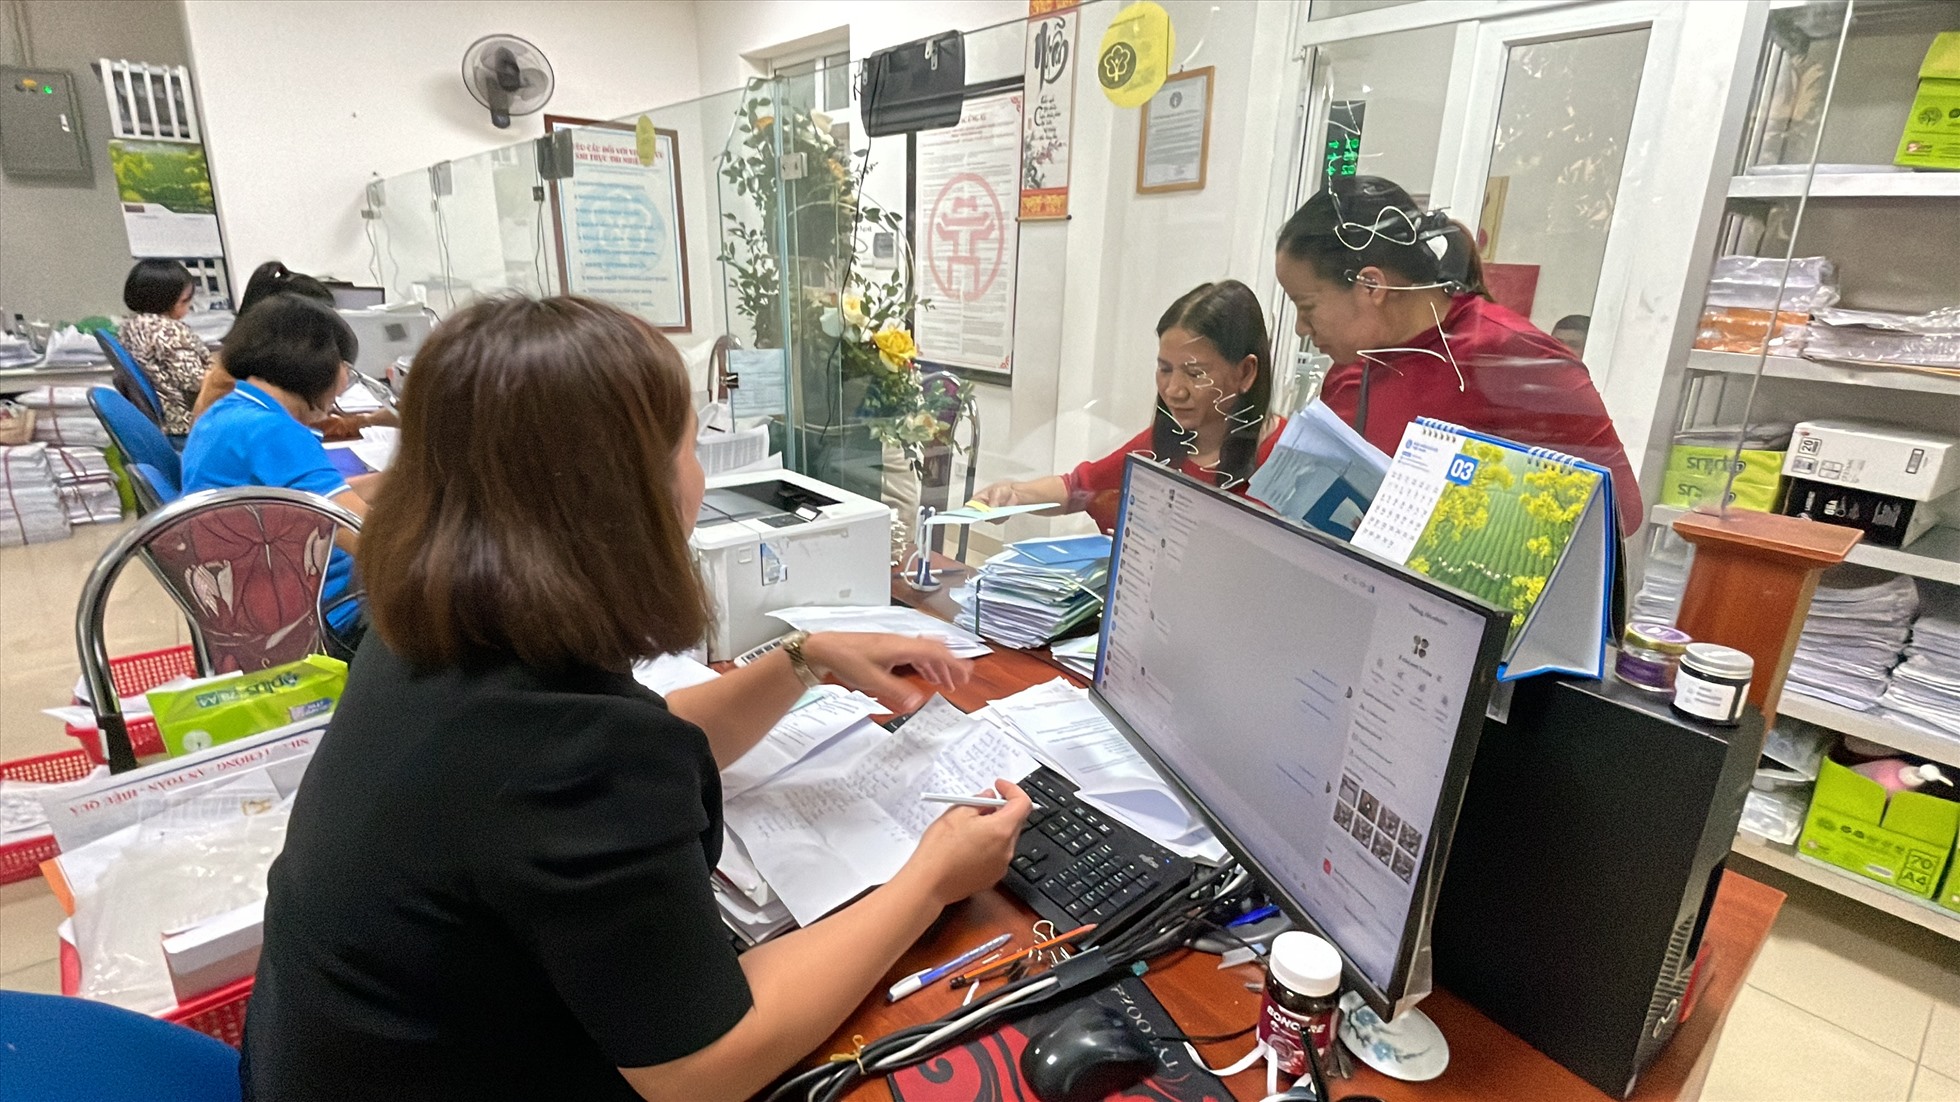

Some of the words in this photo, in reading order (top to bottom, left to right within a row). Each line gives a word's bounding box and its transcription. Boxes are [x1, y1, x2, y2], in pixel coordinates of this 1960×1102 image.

[1801, 440, 1814, 452] 20
[1450, 458, 1475, 481] 03
[1909, 854, 1934, 870] 70
[1902, 871, 1927, 886] A4
[1266, 1004, 1327, 1033] BONCRE
